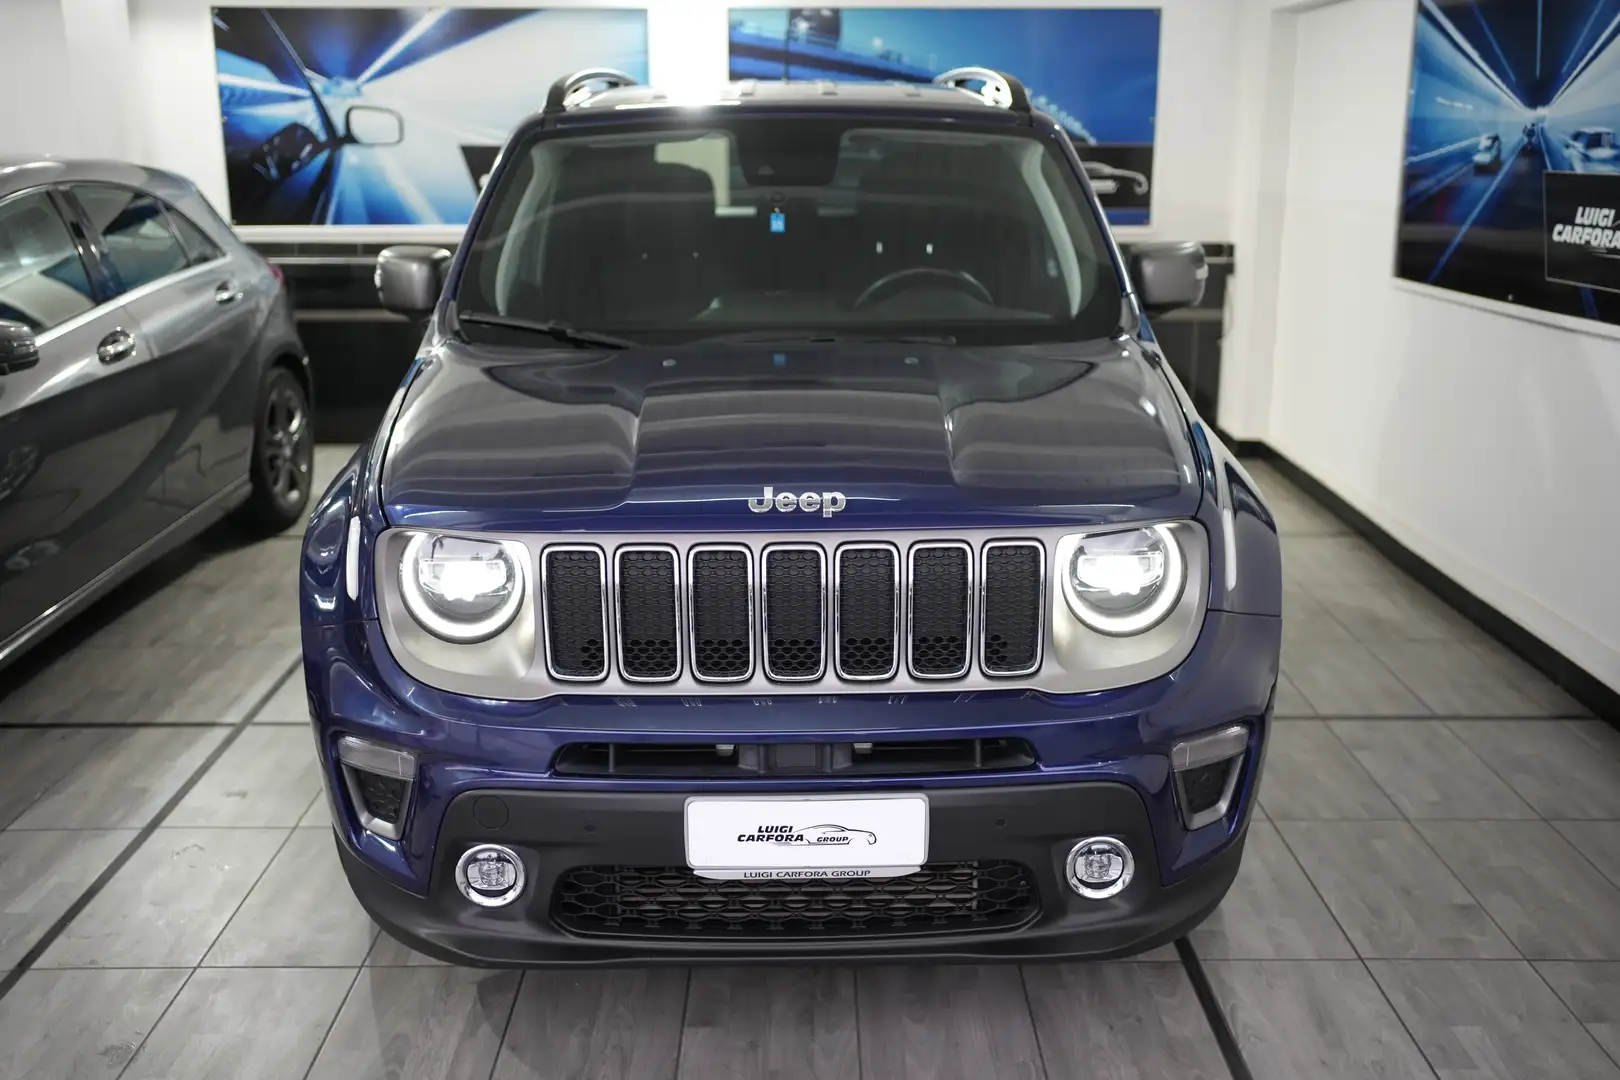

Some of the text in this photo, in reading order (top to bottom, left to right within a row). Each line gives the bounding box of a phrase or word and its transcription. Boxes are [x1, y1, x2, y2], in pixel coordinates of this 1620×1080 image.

[1574, 206, 1616, 227] LUIGI
[1552, 223, 1620, 249] CARFORA
[748, 486, 846, 518] Jeep
[757, 825, 794, 834] LUIGI
[737, 834, 804, 842] CARFORA
[743, 869, 871, 879] LUIGI CARFORA GROUP
